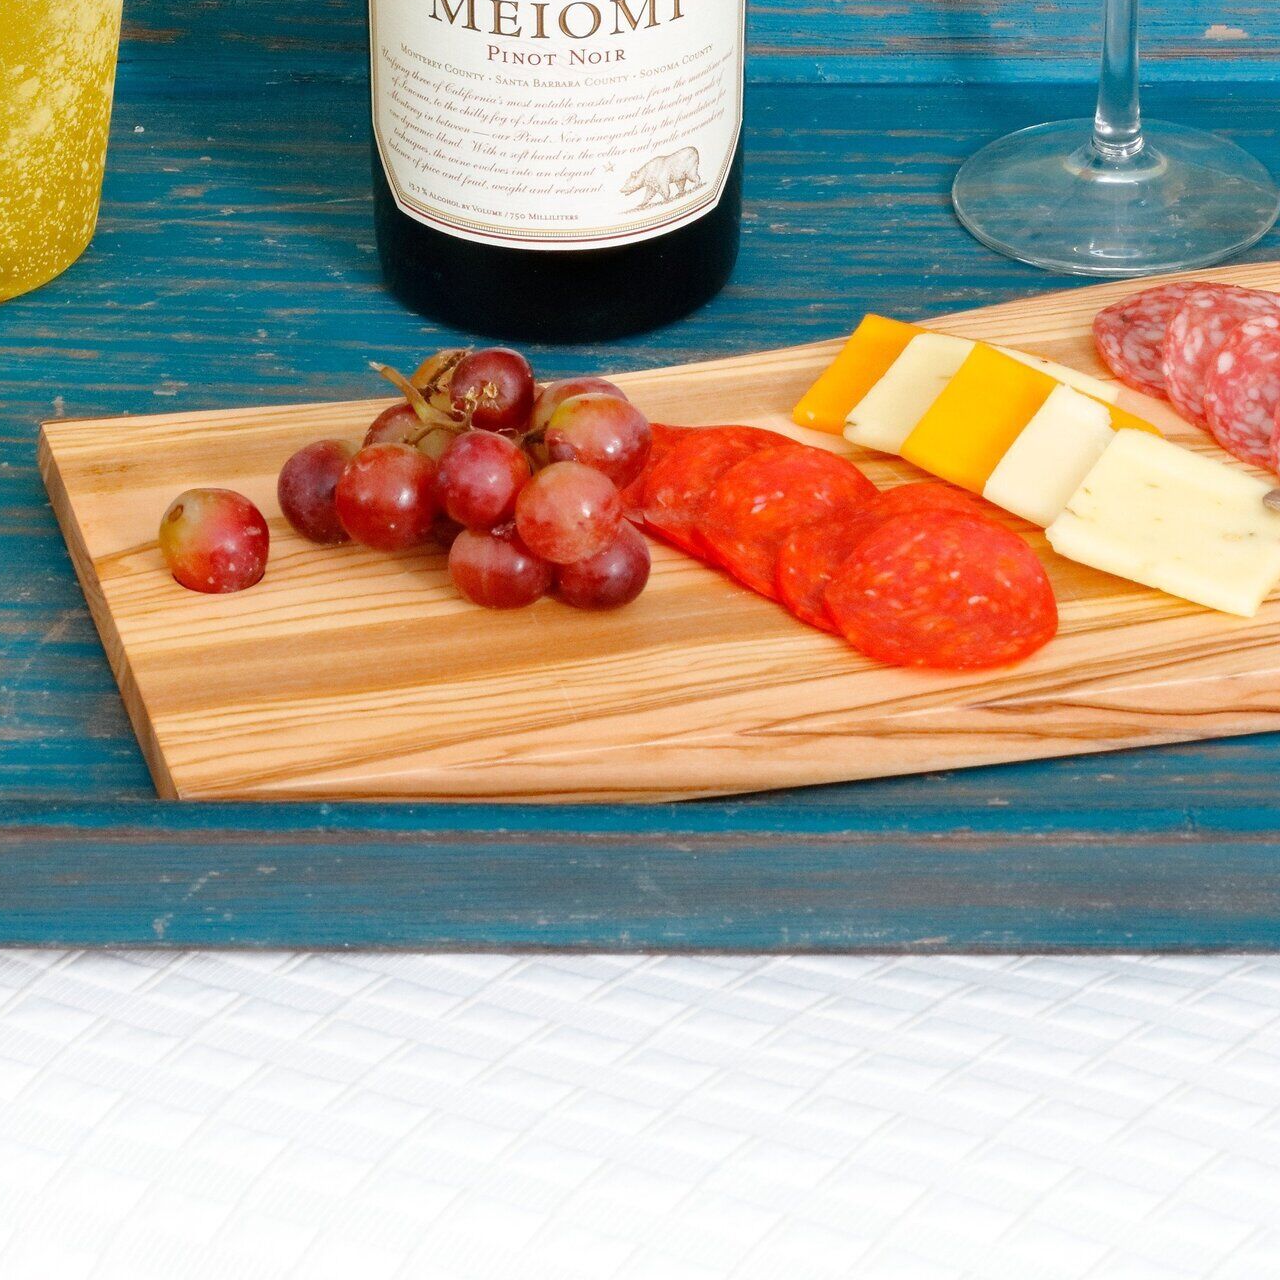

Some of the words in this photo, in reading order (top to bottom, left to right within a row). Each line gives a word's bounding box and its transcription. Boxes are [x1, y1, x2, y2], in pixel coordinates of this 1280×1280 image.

[400, 42, 442, 70] MONTEREY
[444, 63, 485, 81] COUNTY
[495, 74, 530, 88] SANTA
[533, 78, 581, 88] BARBARA
[584, 75, 629, 87] COUNTY
[639, 63, 680, 79] SONOMA
[487, 44, 557, 66] PINOT
[569, 49, 627, 66] NOIR
[411, 69, 431, 86] three
[432, 80, 443, 93] of
[445, 82, 503, 106] California's
[507, 100, 532, 108] most
[534, 98, 572, 108] notable
[577, 94, 616, 108] coastal
[646, 86, 671, 101] from
[673, 78, 686, 89] the
[424, 112, 434, 121] in
[435, 115, 470, 134] between
[513, 130, 549, 143] Pinot
[551, 130, 581, 143] Noir
[585, 125, 638, 144] vineyards
[640, 123, 657, 136] lay
[660, 117, 674, 128] the
[434, 99, 442, 107] to
[444, 101, 458, 112] the
[459, 106, 488, 122] chilly
[489, 112, 508, 125] fog
[510, 115, 522, 128] of
[522, 115, 559, 126] Santa
[561, 113, 615, 126] Barbara
[617, 106, 641, 120] and
[641, 104, 656, 116] the
[658, 95, 693, 111] howling
[400, 115, 435, 139] dynamic
[473, 140, 497, 155] With
[510, 149, 529, 163] soft
[530, 150, 562, 160] hand
[562, 151, 574, 160] in
[578, 148, 595, 160] the
[597, 145, 627, 159] cellar
[629, 139, 652, 153] and
[652, 130, 680, 150] gentle
[412, 157, 422, 168] of
[421, 162, 441, 176] spice
[441, 172, 463, 182] and
[491, 183, 528, 197] weight
[529, 184, 554, 194] and
[433, 149, 446, 160] the
[448, 156, 471, 167] wine
[473, 162, 508, 175] evolves
[511, 167, 533, 177] into
[554, 167, 597, 182] elegant
